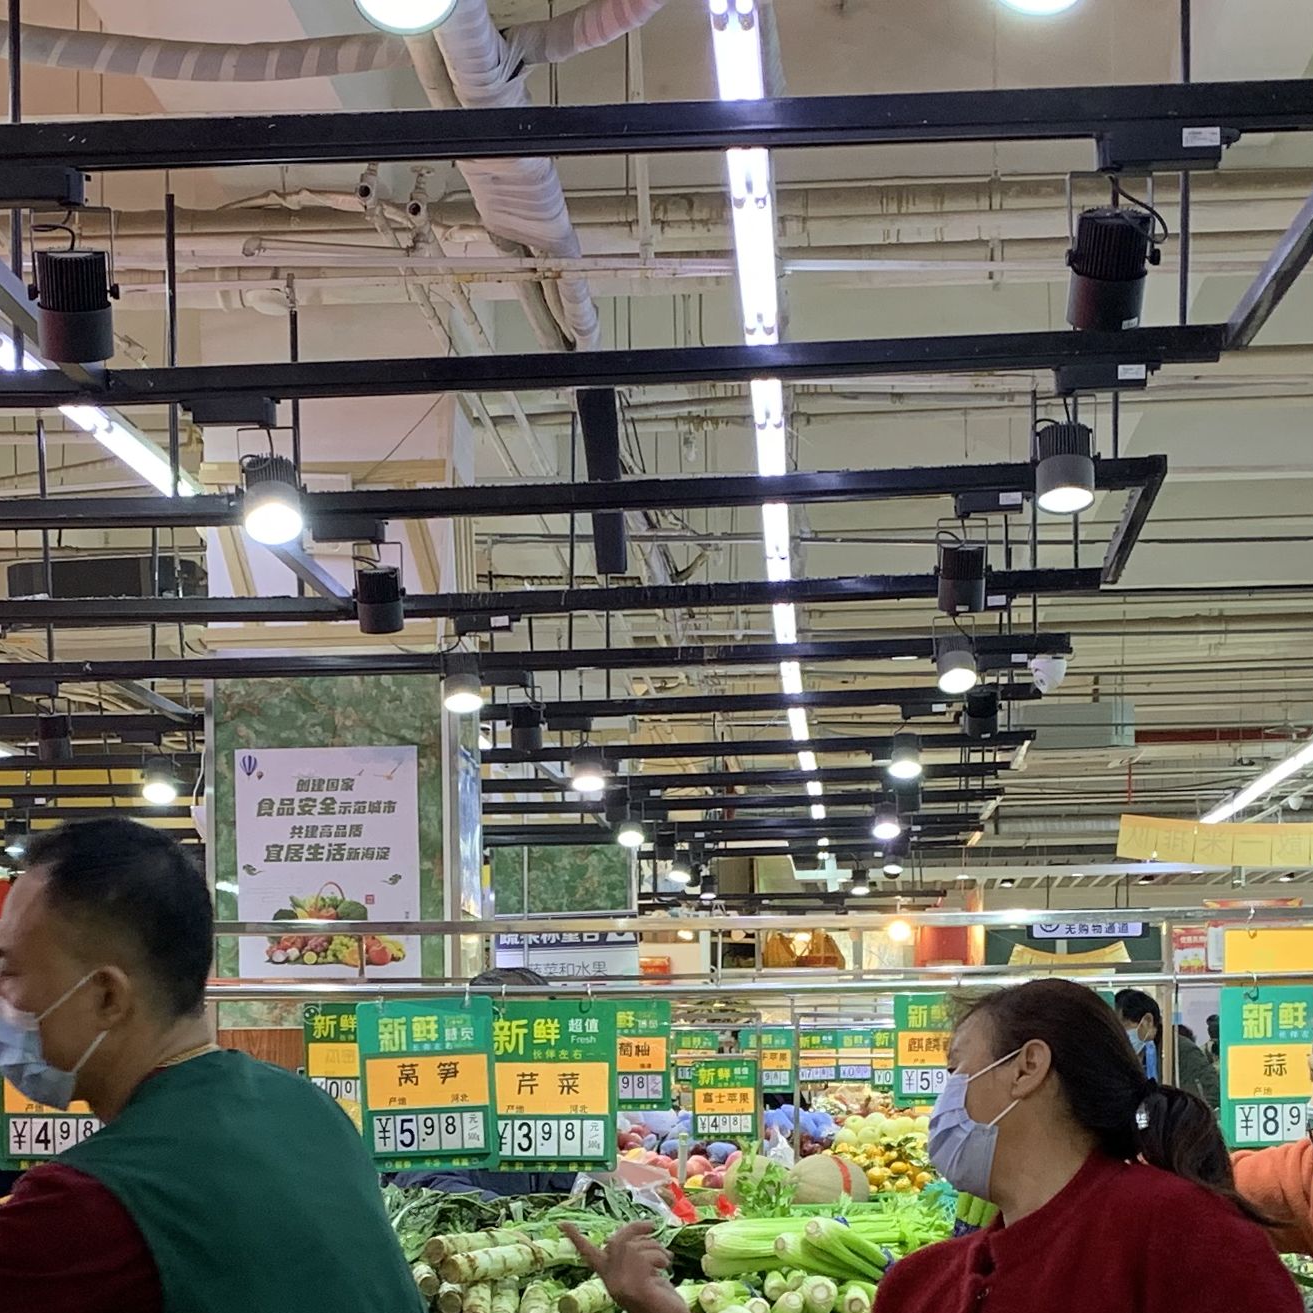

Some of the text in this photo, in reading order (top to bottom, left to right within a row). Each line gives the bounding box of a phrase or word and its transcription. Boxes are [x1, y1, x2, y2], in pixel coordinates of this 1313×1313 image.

[296, 778, 355, 792] 创建国家
[256, 797, 397, 817] 食品安全示范城市
[289, 824, 364, 839] 共建高品质
[264, 843, 391, 863] 宜居生活新海淀
[1242, 1001, 1309, 1039] 新鲜
[378, 1015, 439, 1052] 新鲜
[493, 1018, 561, 1056] 新鲜
[397, 1061, 460, 1087] 莴笋
[1263, 1053, 1288, 1076] 蒜
[516, 1071, 581, 1096] 芹菜
[702, 1092, 750, 1104] 富士苹果
